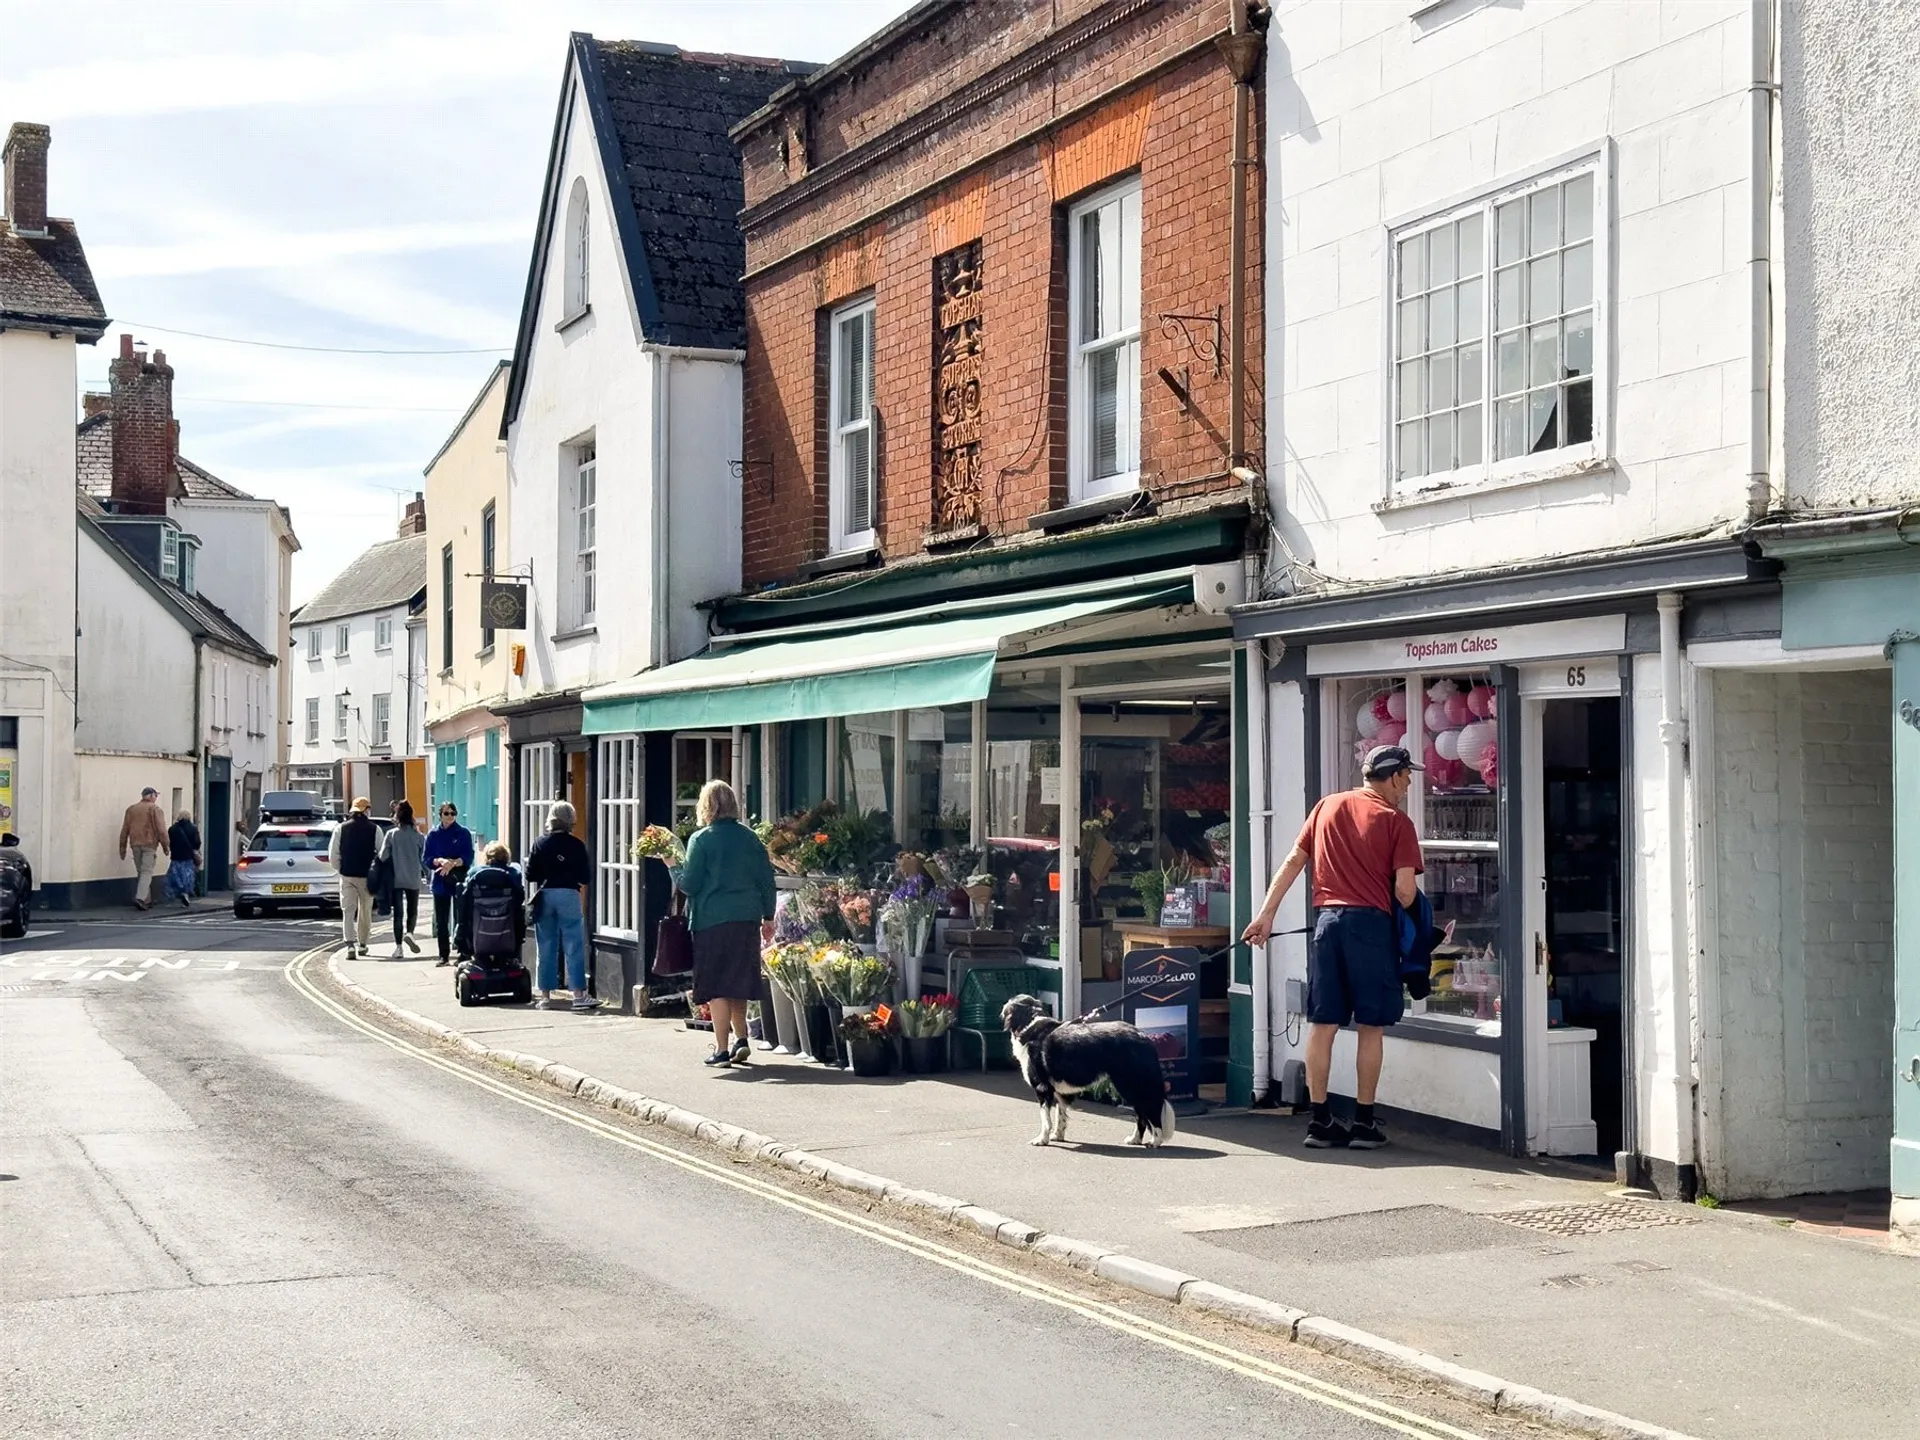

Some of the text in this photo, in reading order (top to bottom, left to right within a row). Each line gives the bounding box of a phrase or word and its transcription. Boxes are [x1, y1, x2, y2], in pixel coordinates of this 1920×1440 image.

[1405, 636, 1498, 661] Topsham Cakes
[1567, 666, 1585, 687] 65
